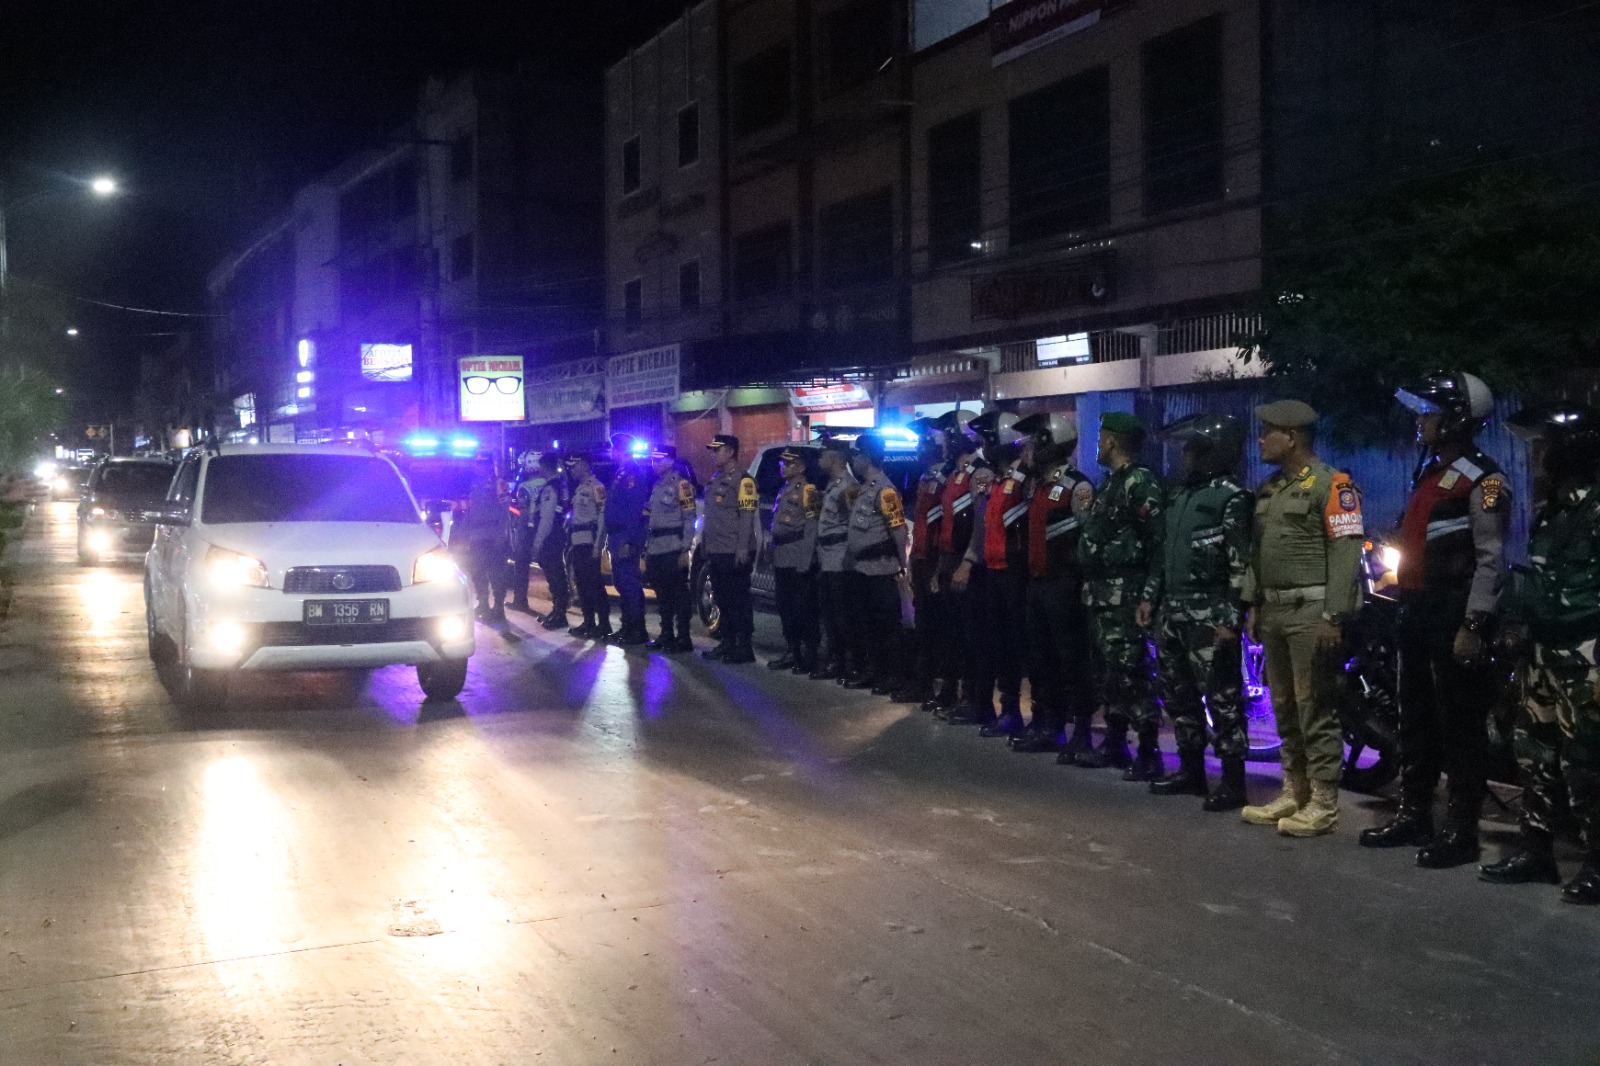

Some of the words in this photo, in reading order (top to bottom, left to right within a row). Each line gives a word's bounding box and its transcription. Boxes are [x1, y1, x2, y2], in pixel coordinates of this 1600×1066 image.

[1009, 0, 1057, 32] NIPPON
[308, 603, 323, 618] BM
[333, 603, 359, 617] 1356
[370, 602, 384, 616] RN
